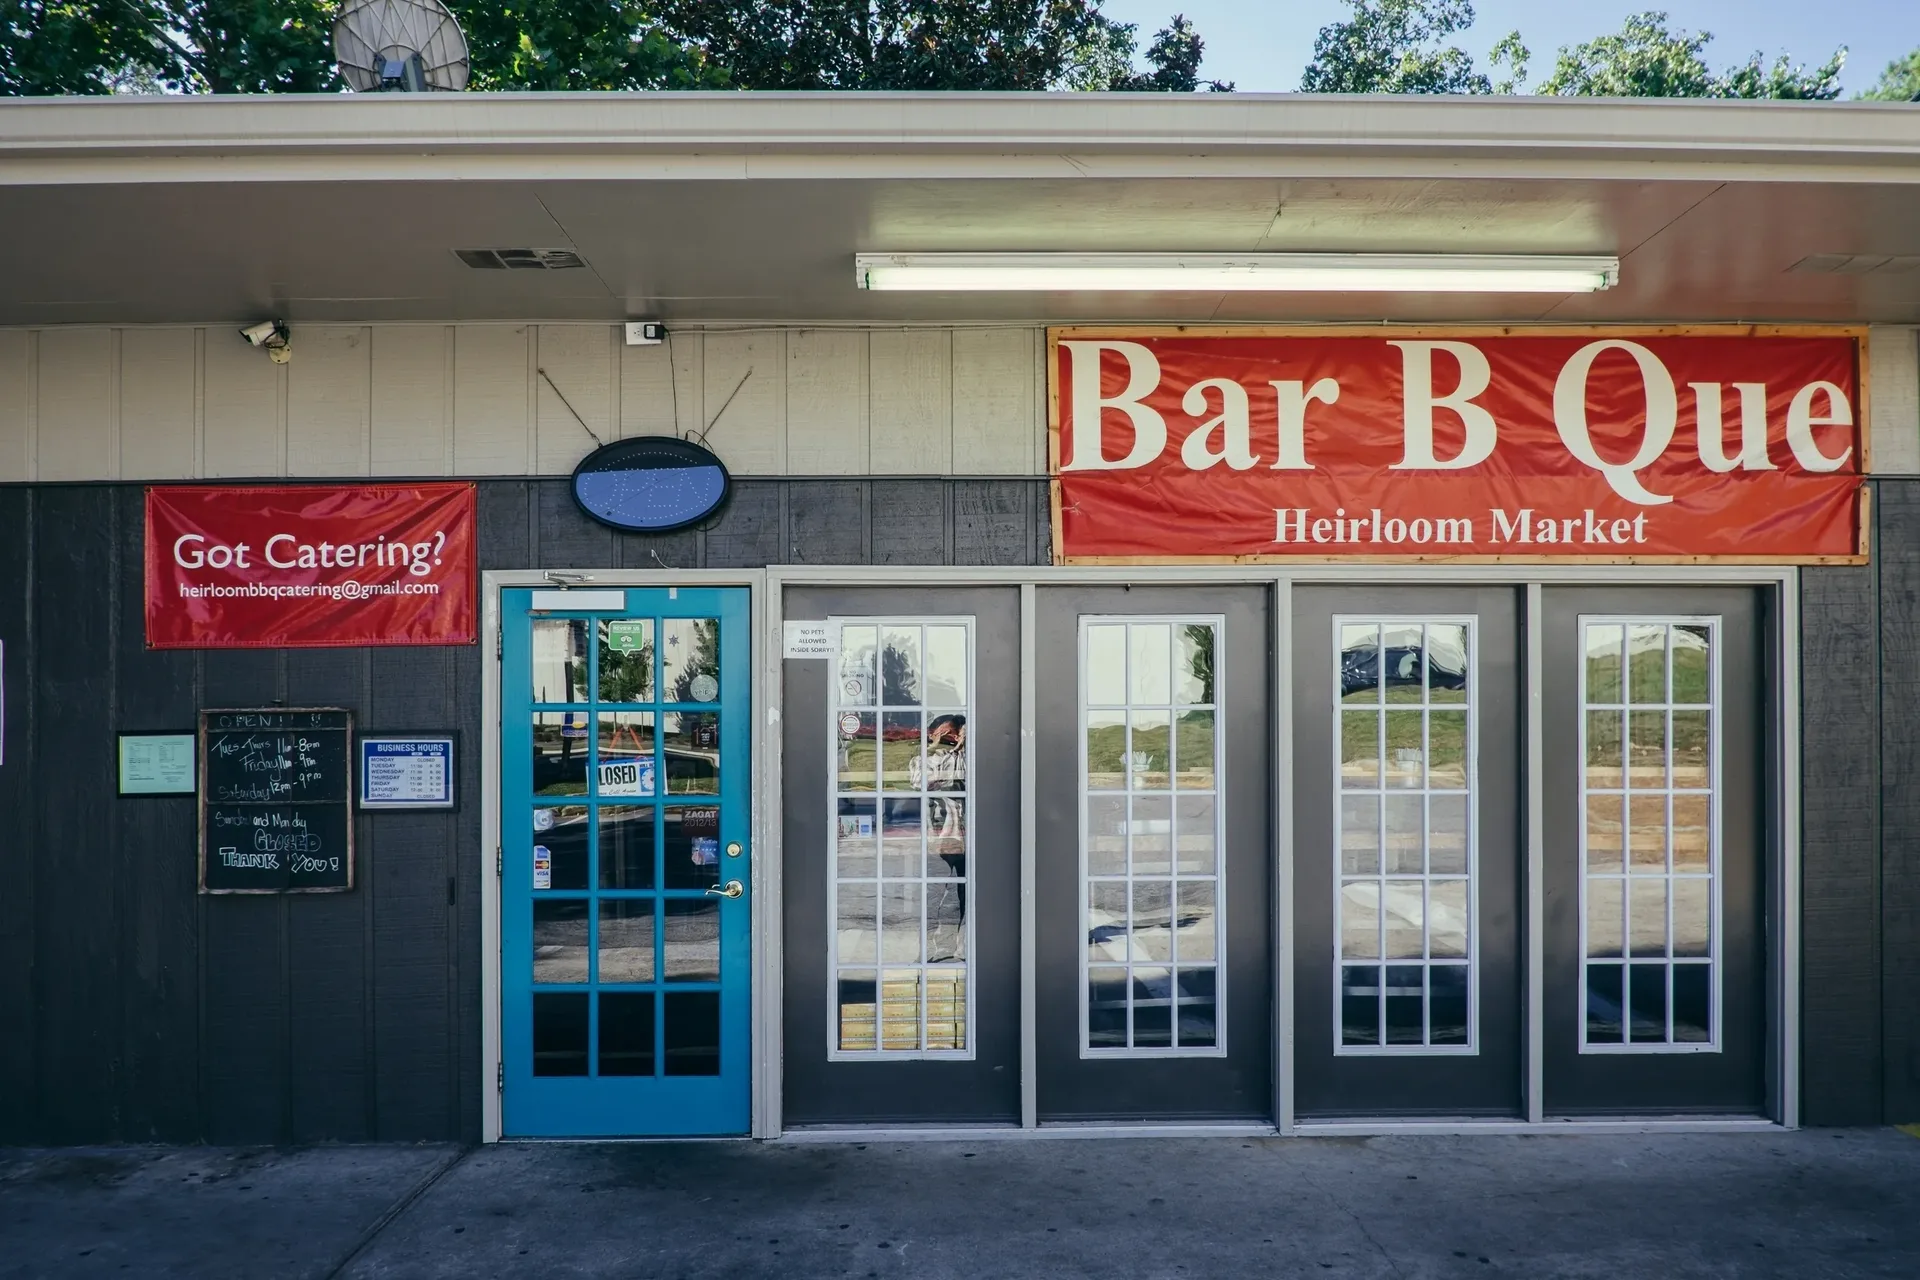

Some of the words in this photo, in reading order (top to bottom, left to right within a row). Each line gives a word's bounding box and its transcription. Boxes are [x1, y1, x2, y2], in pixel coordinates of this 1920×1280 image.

[1059, 340, 1340, 471] Bar
[1386, 340, 1498, 470] B
[1553, 339, 1854, 506] Que
[1272, 507, 1475, 544] Heirloom
[1488, 507, 1649, 545] Market
[173, 533, 251, 569] Got
[265, 531, 446, 576] Catering?
[179, 580, 439, 600] heirloombbqcatering@gmail.com
[377, 744, 416, 752] BUSINESS
[417, 744, 444, 752] HOURS
[239, 752, 281, 782] Friday
[598, 765, 637, 786] LOSED
[252, 812, 269, 827] and
[684, 811, 717, 819] ZAGAT
[684, 818, 717, 827] 2012/13
[254, 828, 322, 852] CLOSED
[219, 846, 280, 870] THANK
